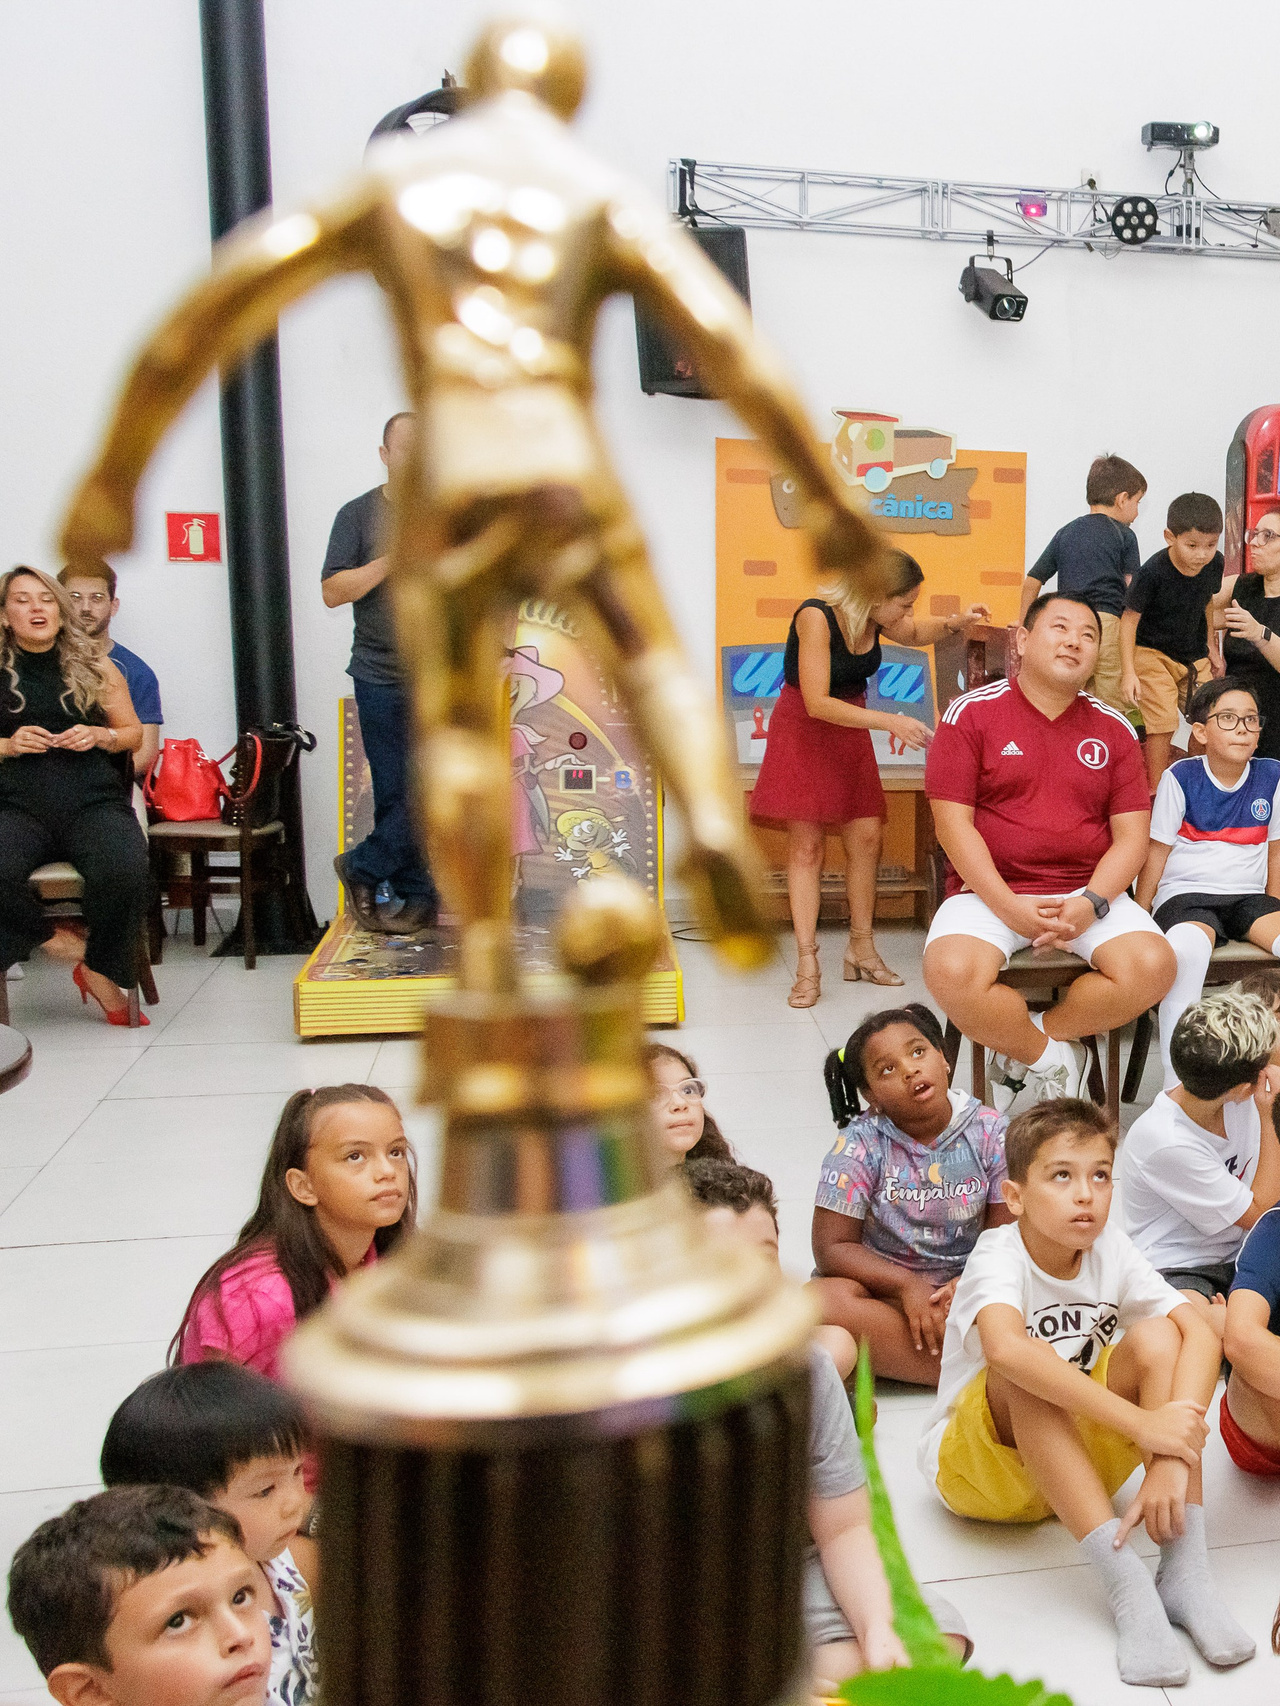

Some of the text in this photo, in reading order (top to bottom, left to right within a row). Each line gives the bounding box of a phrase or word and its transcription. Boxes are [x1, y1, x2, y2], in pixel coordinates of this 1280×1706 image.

[869, 493, 953, 520] cânica
[1084, 743, 1102, 765] J
[614, 770, 632, 789] B
[820, 1167, 849, 1190] MOR
[1035, 1310, 1081, 1338] ON
